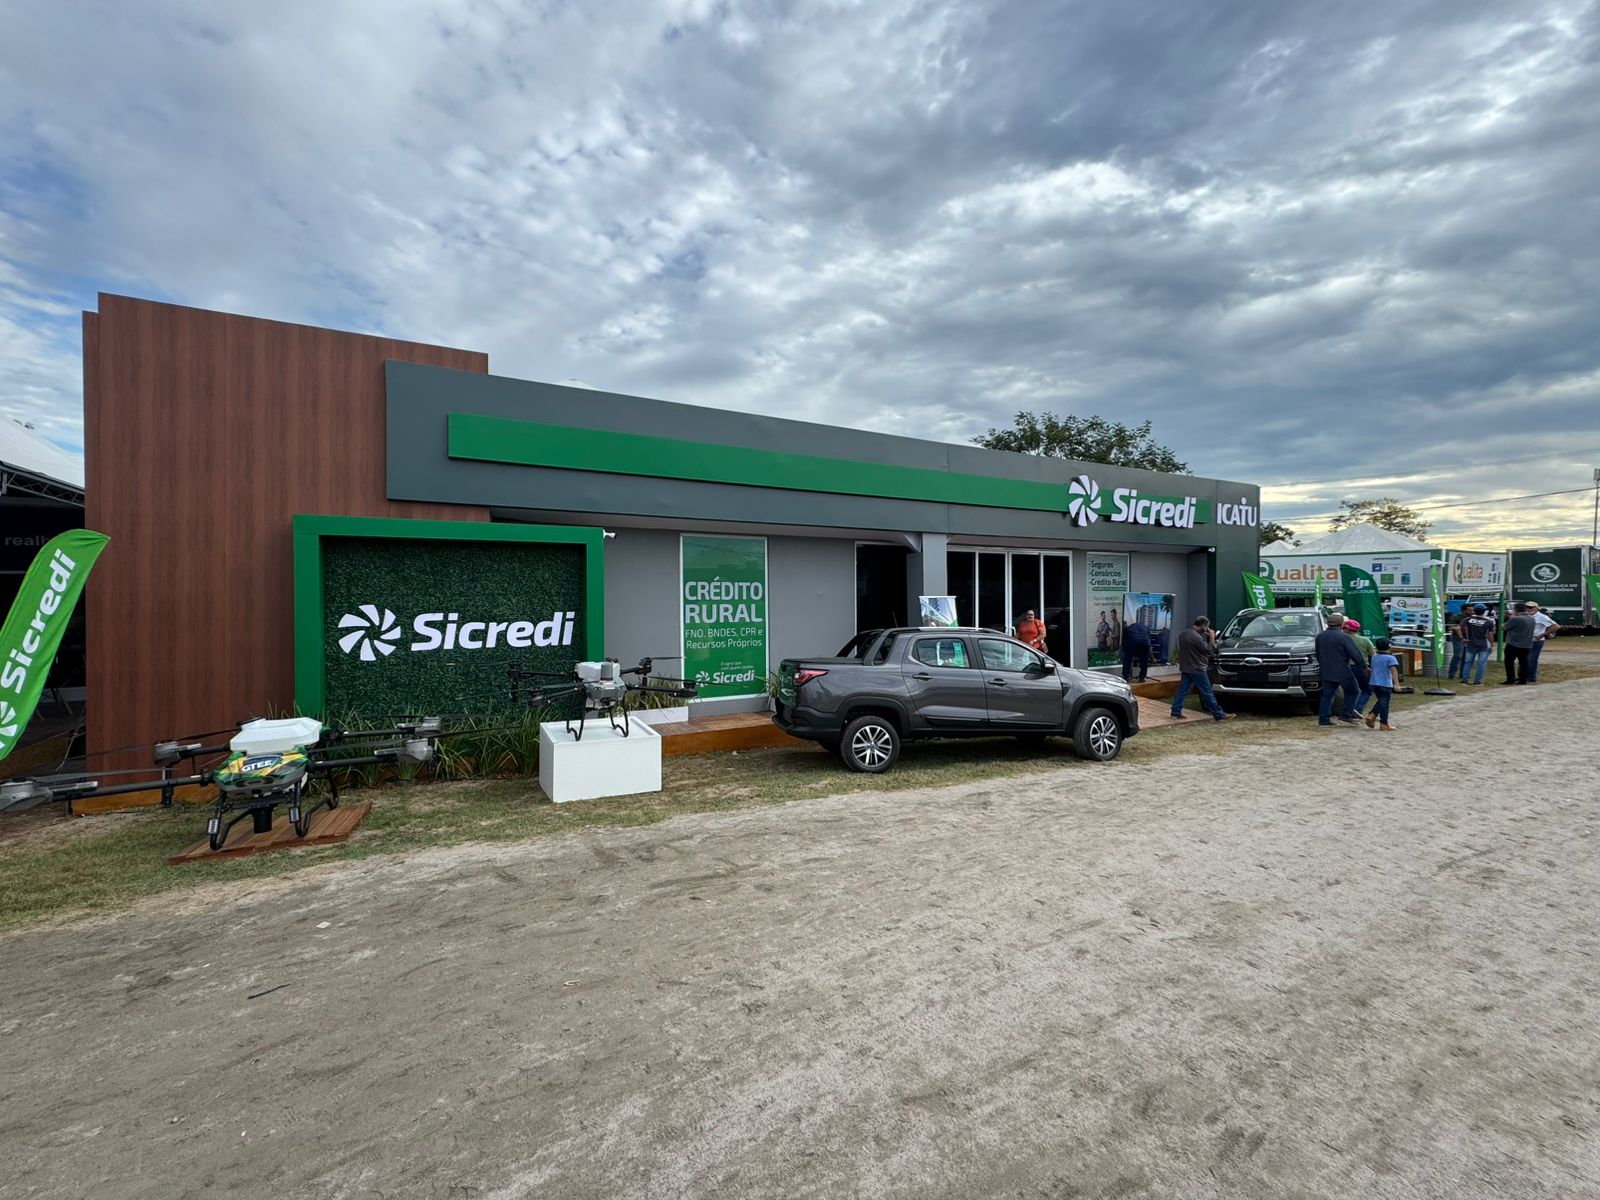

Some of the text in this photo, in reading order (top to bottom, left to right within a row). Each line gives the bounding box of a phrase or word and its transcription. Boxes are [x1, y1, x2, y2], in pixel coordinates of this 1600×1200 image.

[1111, 487, 1197, 529] Sicredi
[1216, 497, 1257, 527] ICATU
[1453, 553, 1483, 584] Qualita
[684, 575, 763, 600] CRÉDITO
[1, 548, 76, 694] Sicredi
[685, 603, 763, 624] RURAL
[411, 611, 576, 652] Sicredi
[686, 638, 762, 650] Recursos Próprios
[707, 628, 739, 638] BNDES,
[740, 627, 756, 636] CPR
[712, 669, 755, 684] Sicredi
